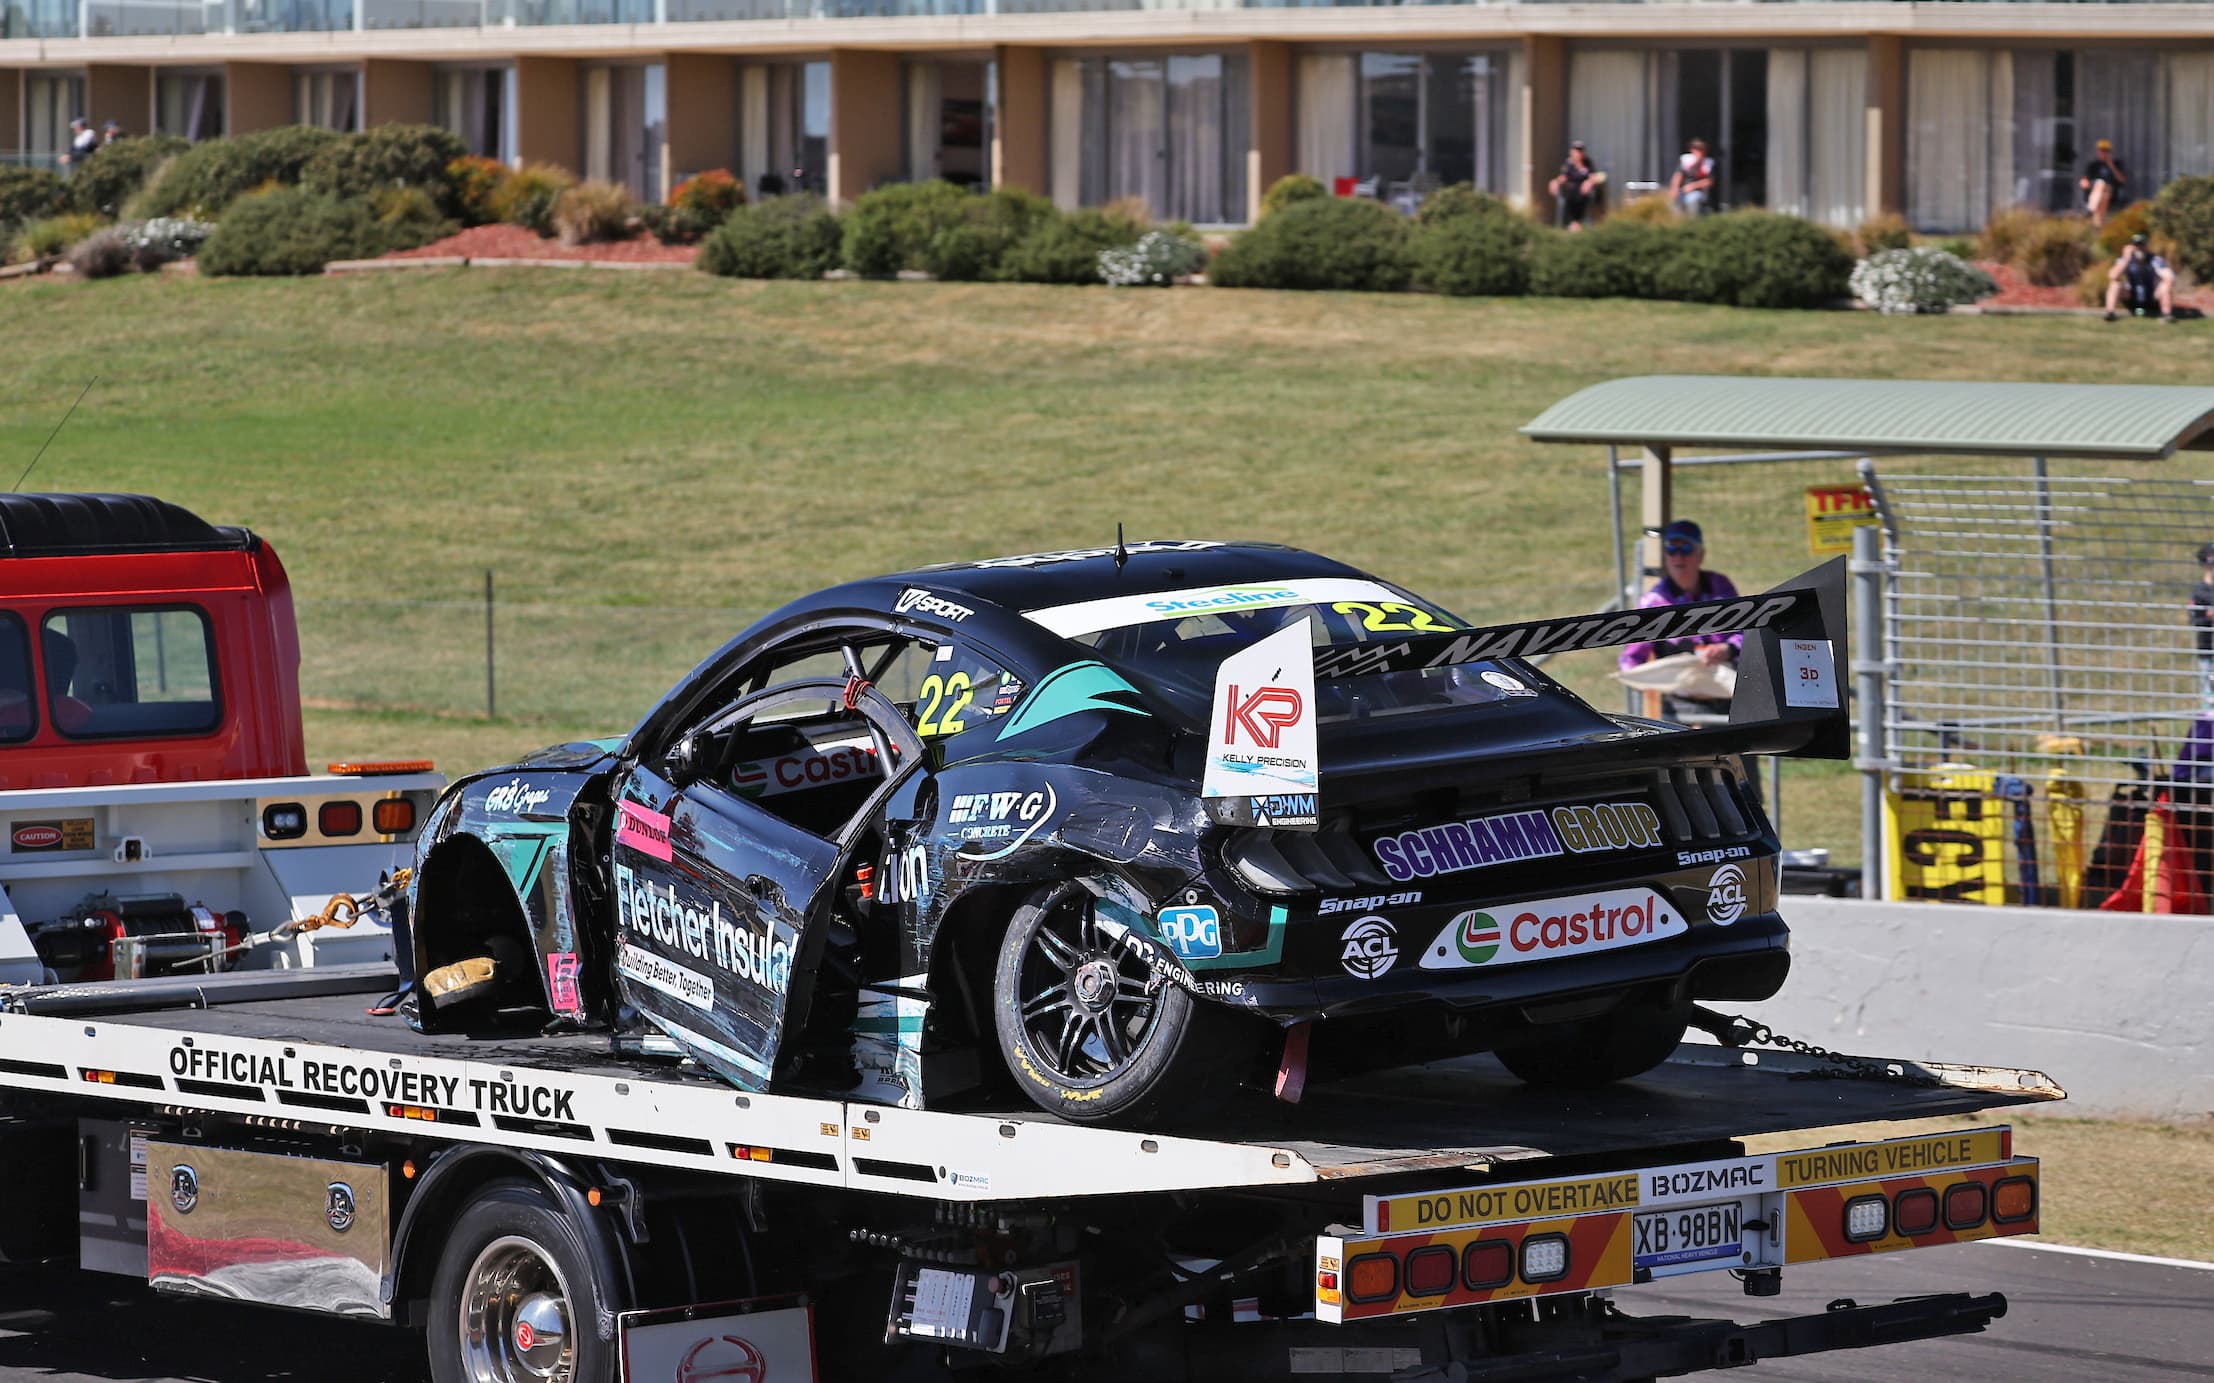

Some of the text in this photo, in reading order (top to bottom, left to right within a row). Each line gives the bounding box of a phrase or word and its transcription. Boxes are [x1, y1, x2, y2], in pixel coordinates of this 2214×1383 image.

[1145, 590, 1299, 612] Steeline
[1332, 602, 1455, 632] 22
[1427, 596, 1797, 667] NAVIGATOR
[1800, 667, 1819, 680] 3D
[917, 671, 973, 737] 22
[1225, 684, 1303, 749] KP
[1222, 753, 1307, 769] KELLY PRECISION
[20, 831, 57, 841] CAUTION
[960, 824, 1012, 839] CONCRETE
[1374, 802, 1664, 882] SCHRAMM GROUP
[1677, 845, 1751, 866] Snap-on
[1318, 889, 1422, 916] Snap-on
[1707, 884, 1747, 907] ACL
[616, 862, 710, 961] Fletcher
[1510, 895, 1654, 953] Castrol
[1341, 936, 1399, 960] ACL
[679, 972, 711, 1001] Together
[1156, 957, 1243, 996] ENGINEERING
[170, 1046, 576, 1121] OFFICIAL RECOVERY TRUCK
[1785, 1138, 1972, 1183] TURNING VEHICLE
[1652, 1164, 1764, 1197] BOZMAC
[1418, 1177, 1638, 1224] DO NOT OVERTAKE
[1656, 1254, 1680, 1262] NATIONAL
[1698, 1247, 1718, 1256] VEHICLE
